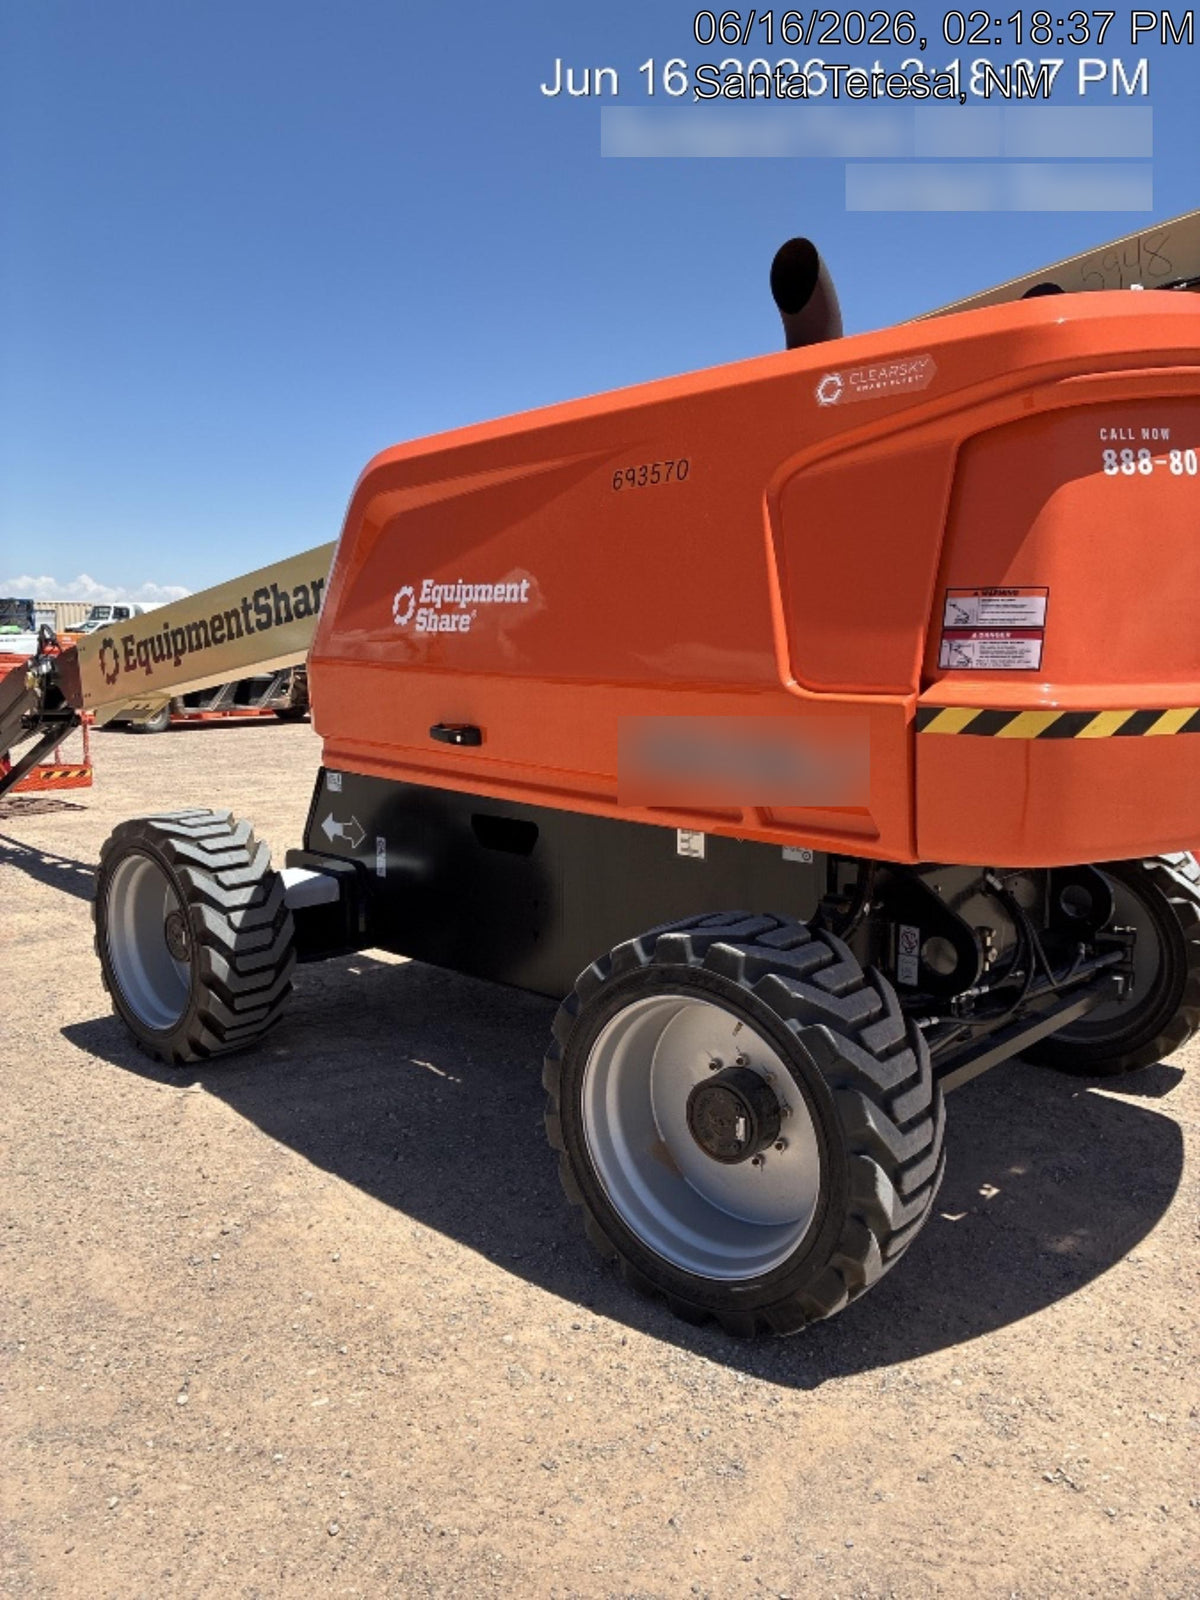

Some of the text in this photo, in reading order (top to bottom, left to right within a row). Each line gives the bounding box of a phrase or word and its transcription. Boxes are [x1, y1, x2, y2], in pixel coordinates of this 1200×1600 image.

[849, 359, 929, 385] CLEARSKY
[1099, 427, 1170, 441] CALL NOW
[612, 458, 690, 491] 693570
[1102, 448, 1198, 476] 888-80
[419, 578, 530, 608] Equipment
[415, 608, 472, 633] Share
